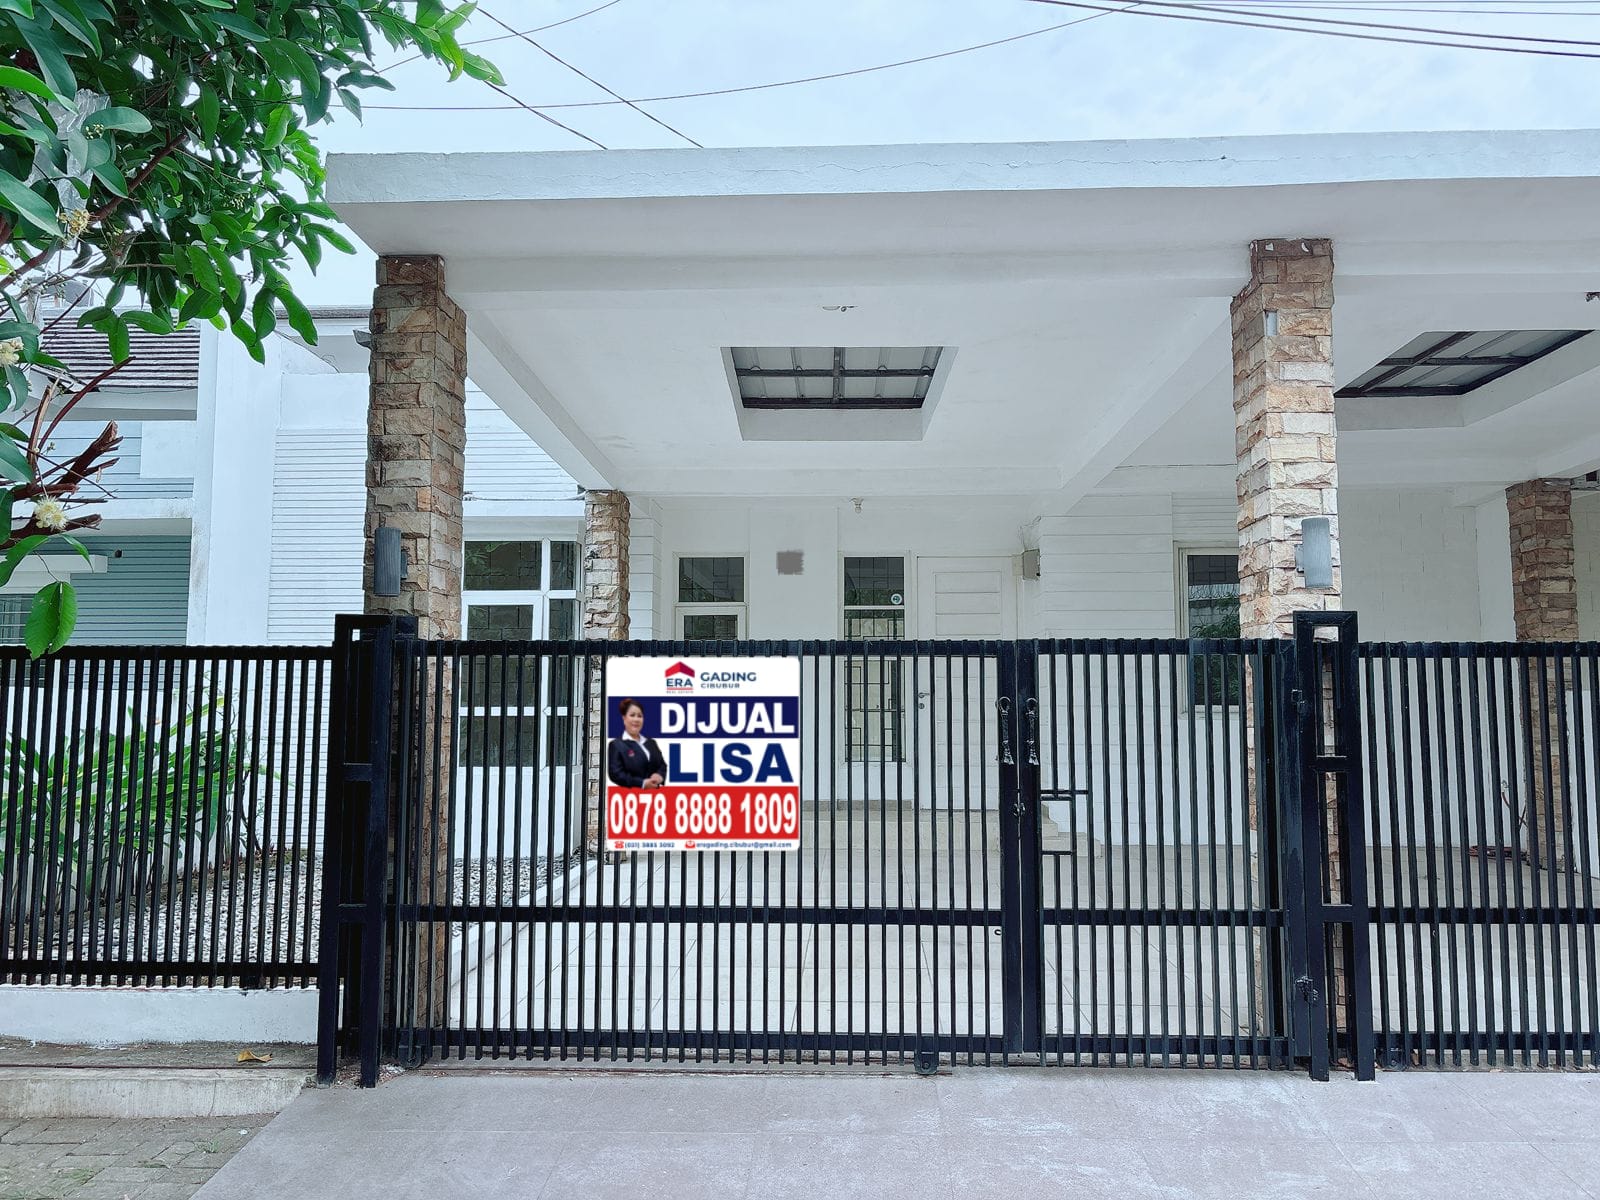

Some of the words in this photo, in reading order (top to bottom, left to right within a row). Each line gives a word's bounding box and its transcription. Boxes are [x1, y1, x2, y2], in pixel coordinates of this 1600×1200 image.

[666, 678, 693, 687] ERA
[700, 672, 757, 682] GADING
[660, 702, 795, 734] DIJUAL
[669, 742, 794, 783] LISA
[610, 792, 667, 834] 0878
[675, 792, 732, 834] 8888
[740, 792, 797, 834] 1809
